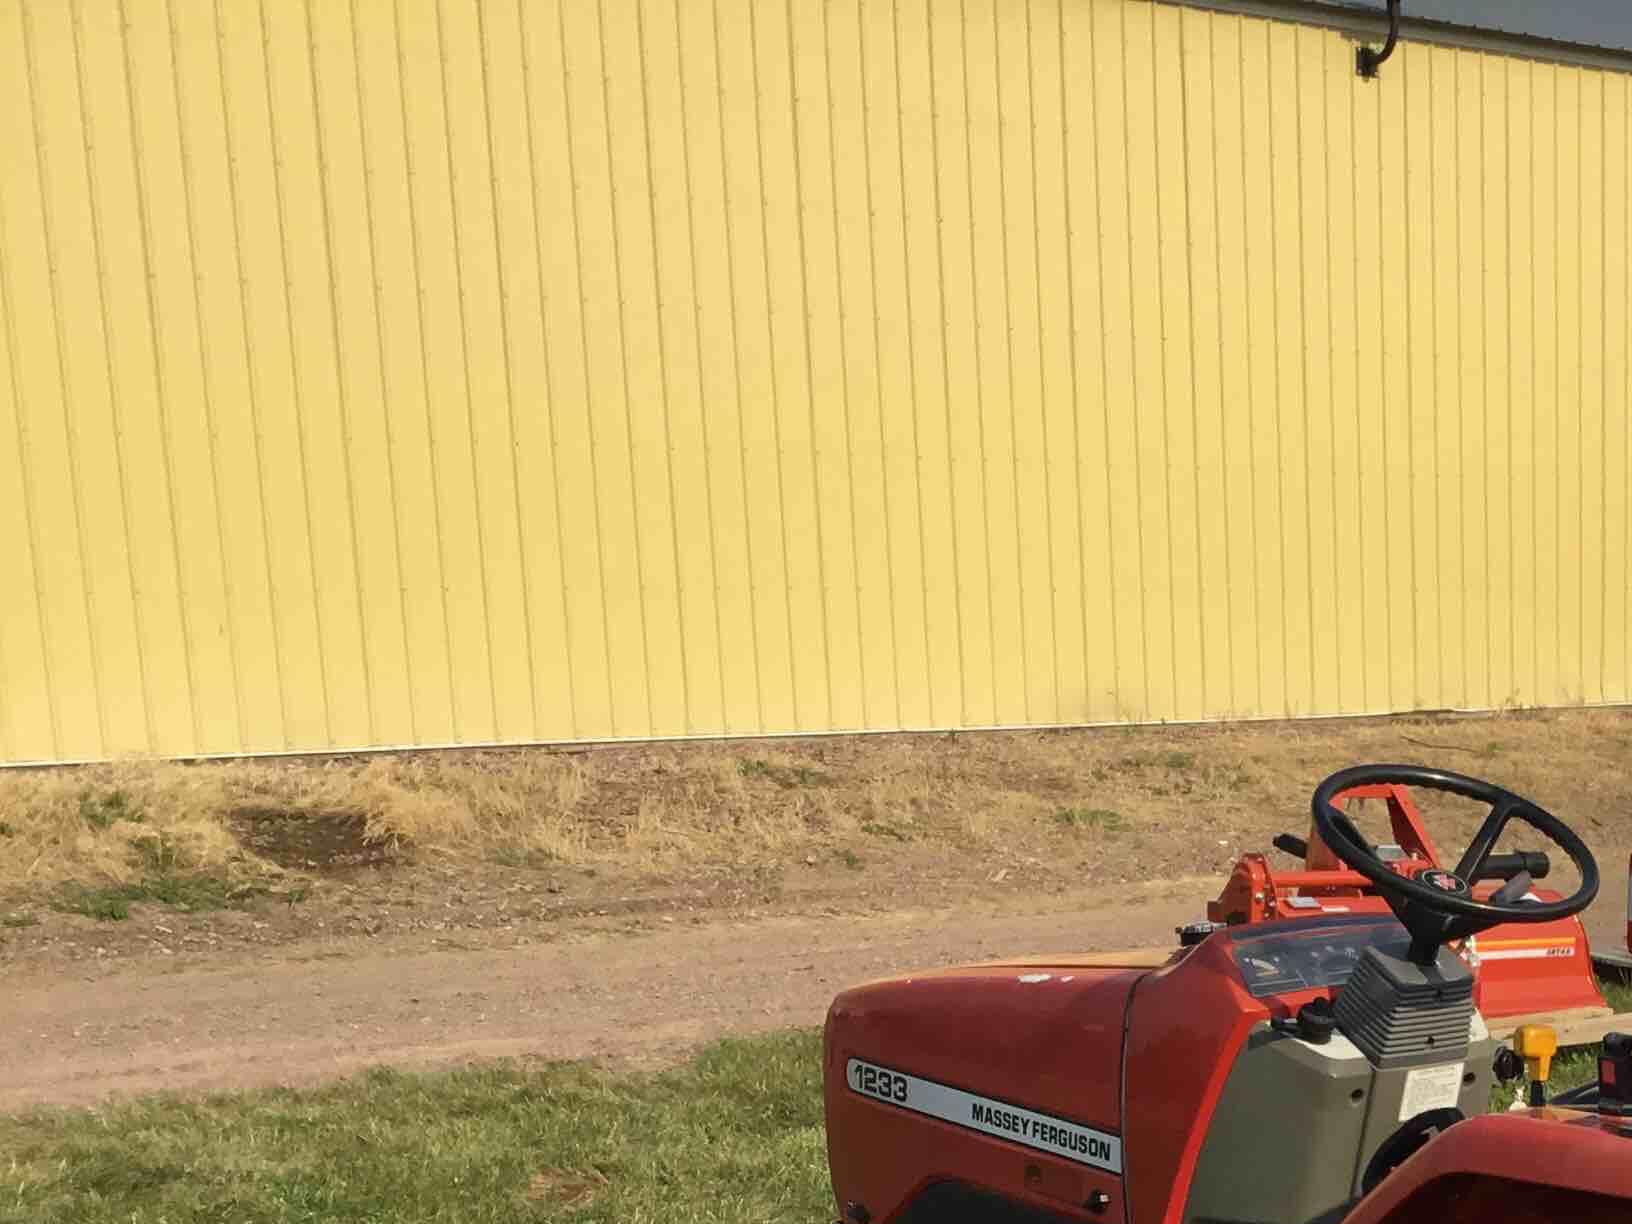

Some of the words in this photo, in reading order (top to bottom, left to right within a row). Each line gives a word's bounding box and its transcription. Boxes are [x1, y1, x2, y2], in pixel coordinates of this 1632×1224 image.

[854, 1063, 909, 1103] 1233
[971, 1102, 1031, 1137] MASSEY
[1031, 1120, 1111, 1162] FERGUSON
